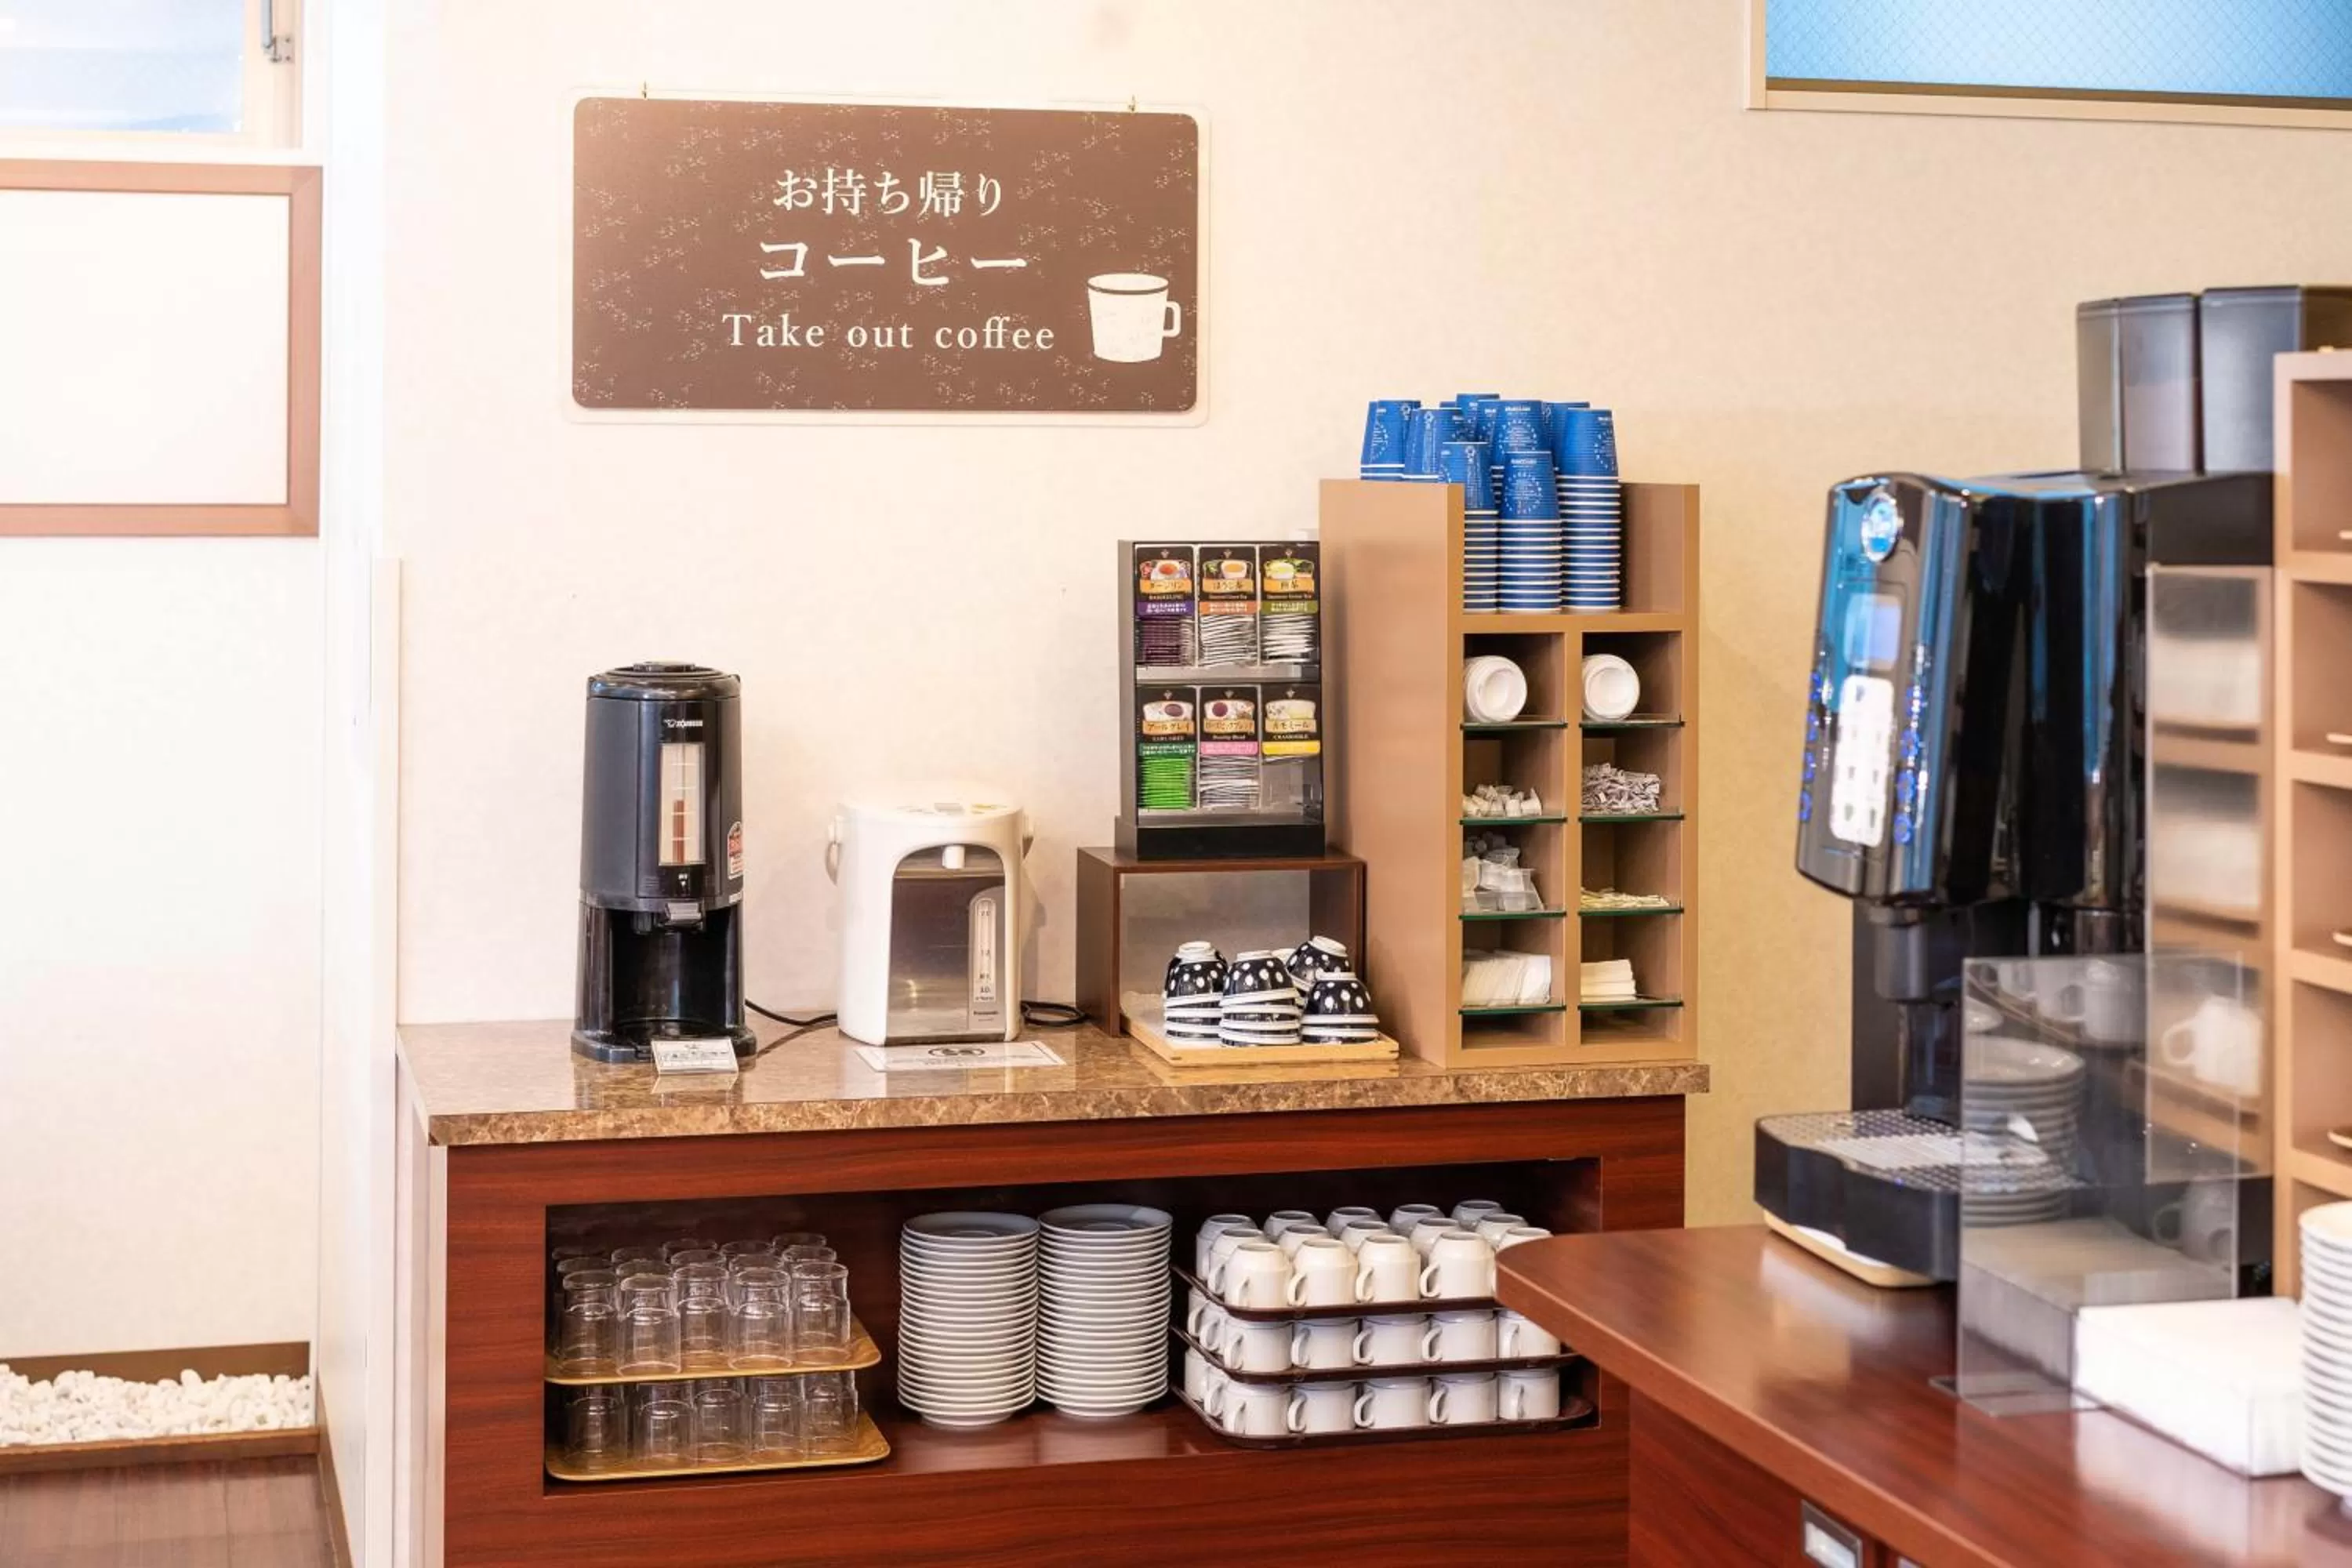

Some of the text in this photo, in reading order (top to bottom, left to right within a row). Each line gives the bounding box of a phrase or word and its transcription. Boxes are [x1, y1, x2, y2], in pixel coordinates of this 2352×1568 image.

[773, 168, 1002, 217] お持ち帰り
[759, 238, 1028, 286] コーヒー
[721, 313, 1054, 349] Take out coffee
